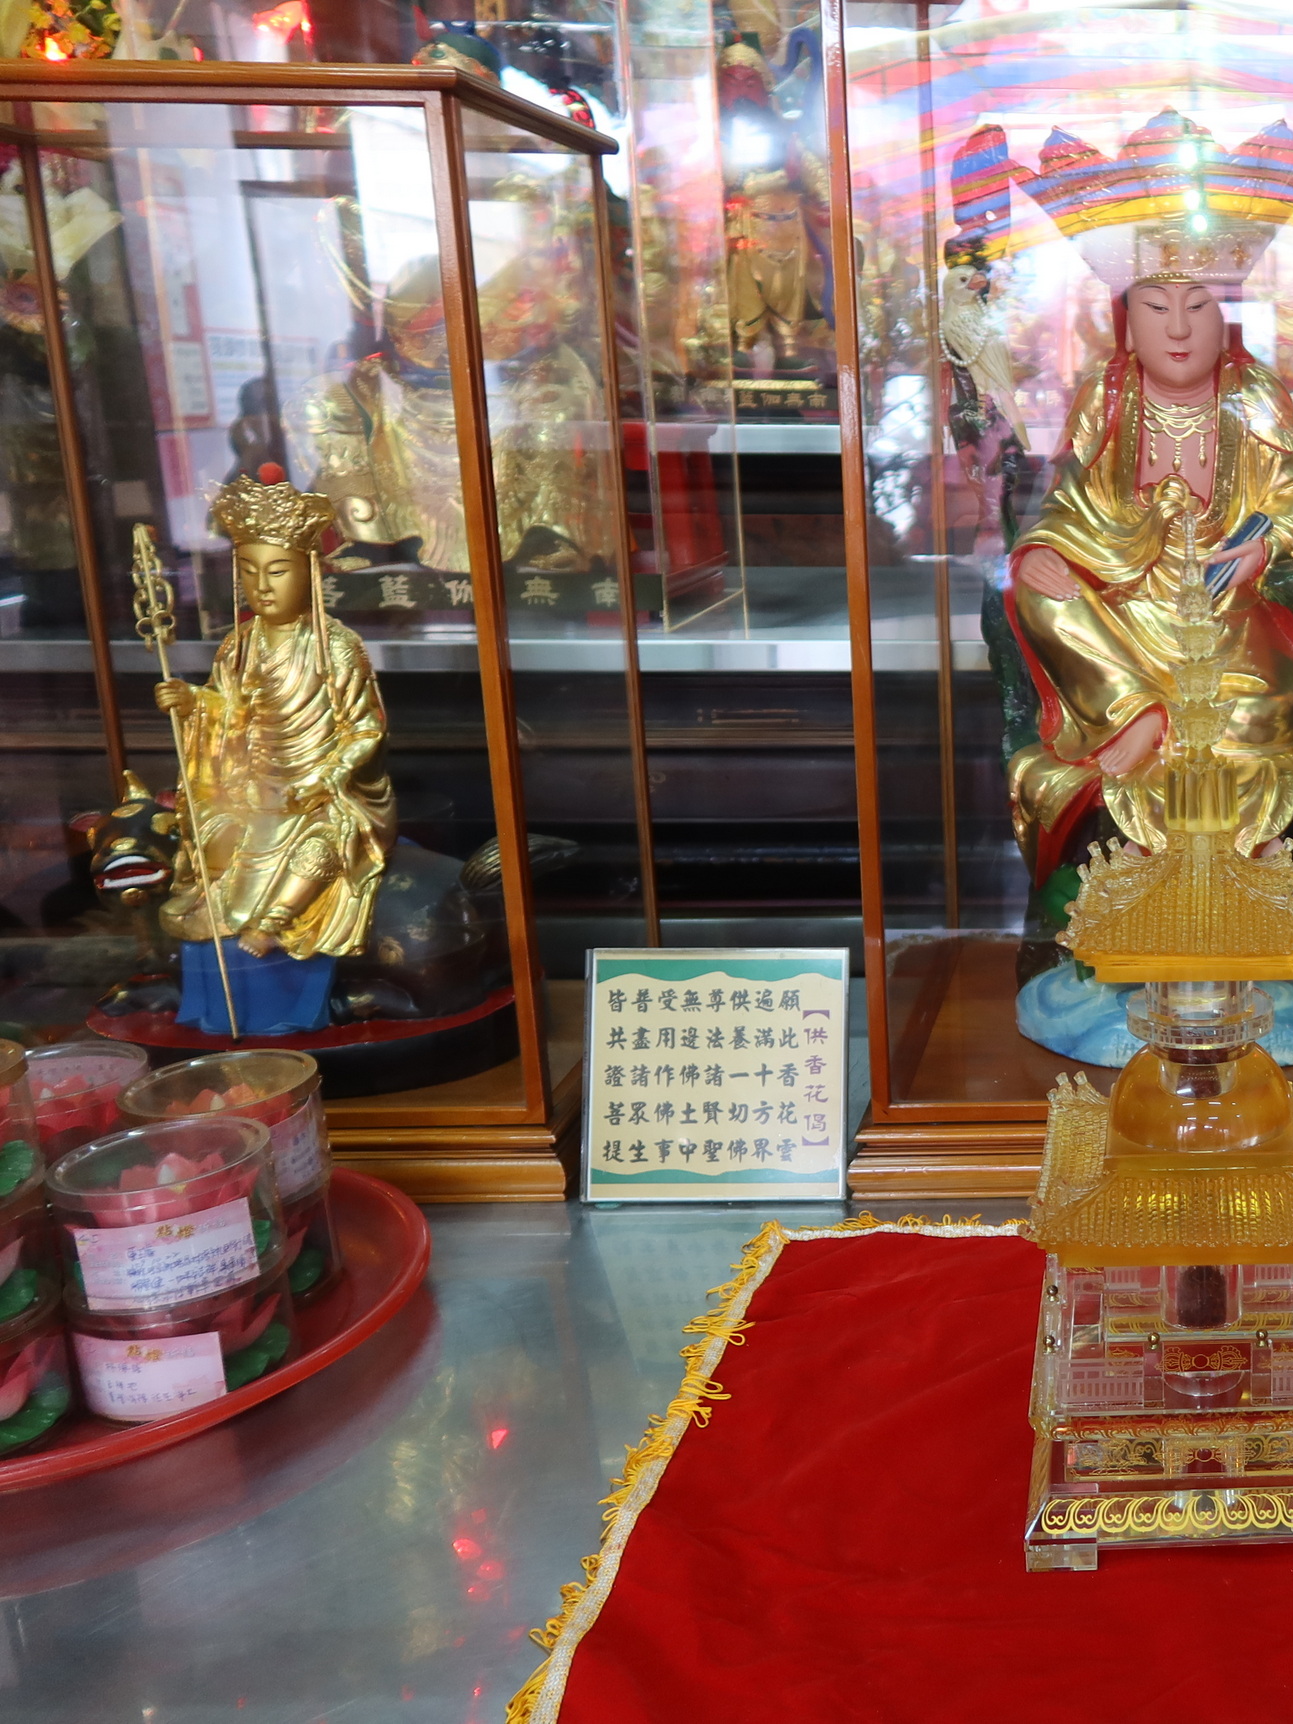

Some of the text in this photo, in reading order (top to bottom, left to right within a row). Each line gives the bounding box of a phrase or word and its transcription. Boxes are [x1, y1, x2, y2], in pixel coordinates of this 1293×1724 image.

[238, 574, 620, 609] 南無伽藍菩
[602, 989, 627, 1163] 皆共證菩提
[653, 989, 678, 1163] 受用作佛事
[679, 989, 702, 1162] 無邊佛土中
[702, 989, 726, 1162] 尊法諸賢聖
[727, 989, 752, 1162] 供養一切佛
[751, 989, 776, 1162] 遍滿十方界
[777, 989, 801, 1162] 願此香花雲
